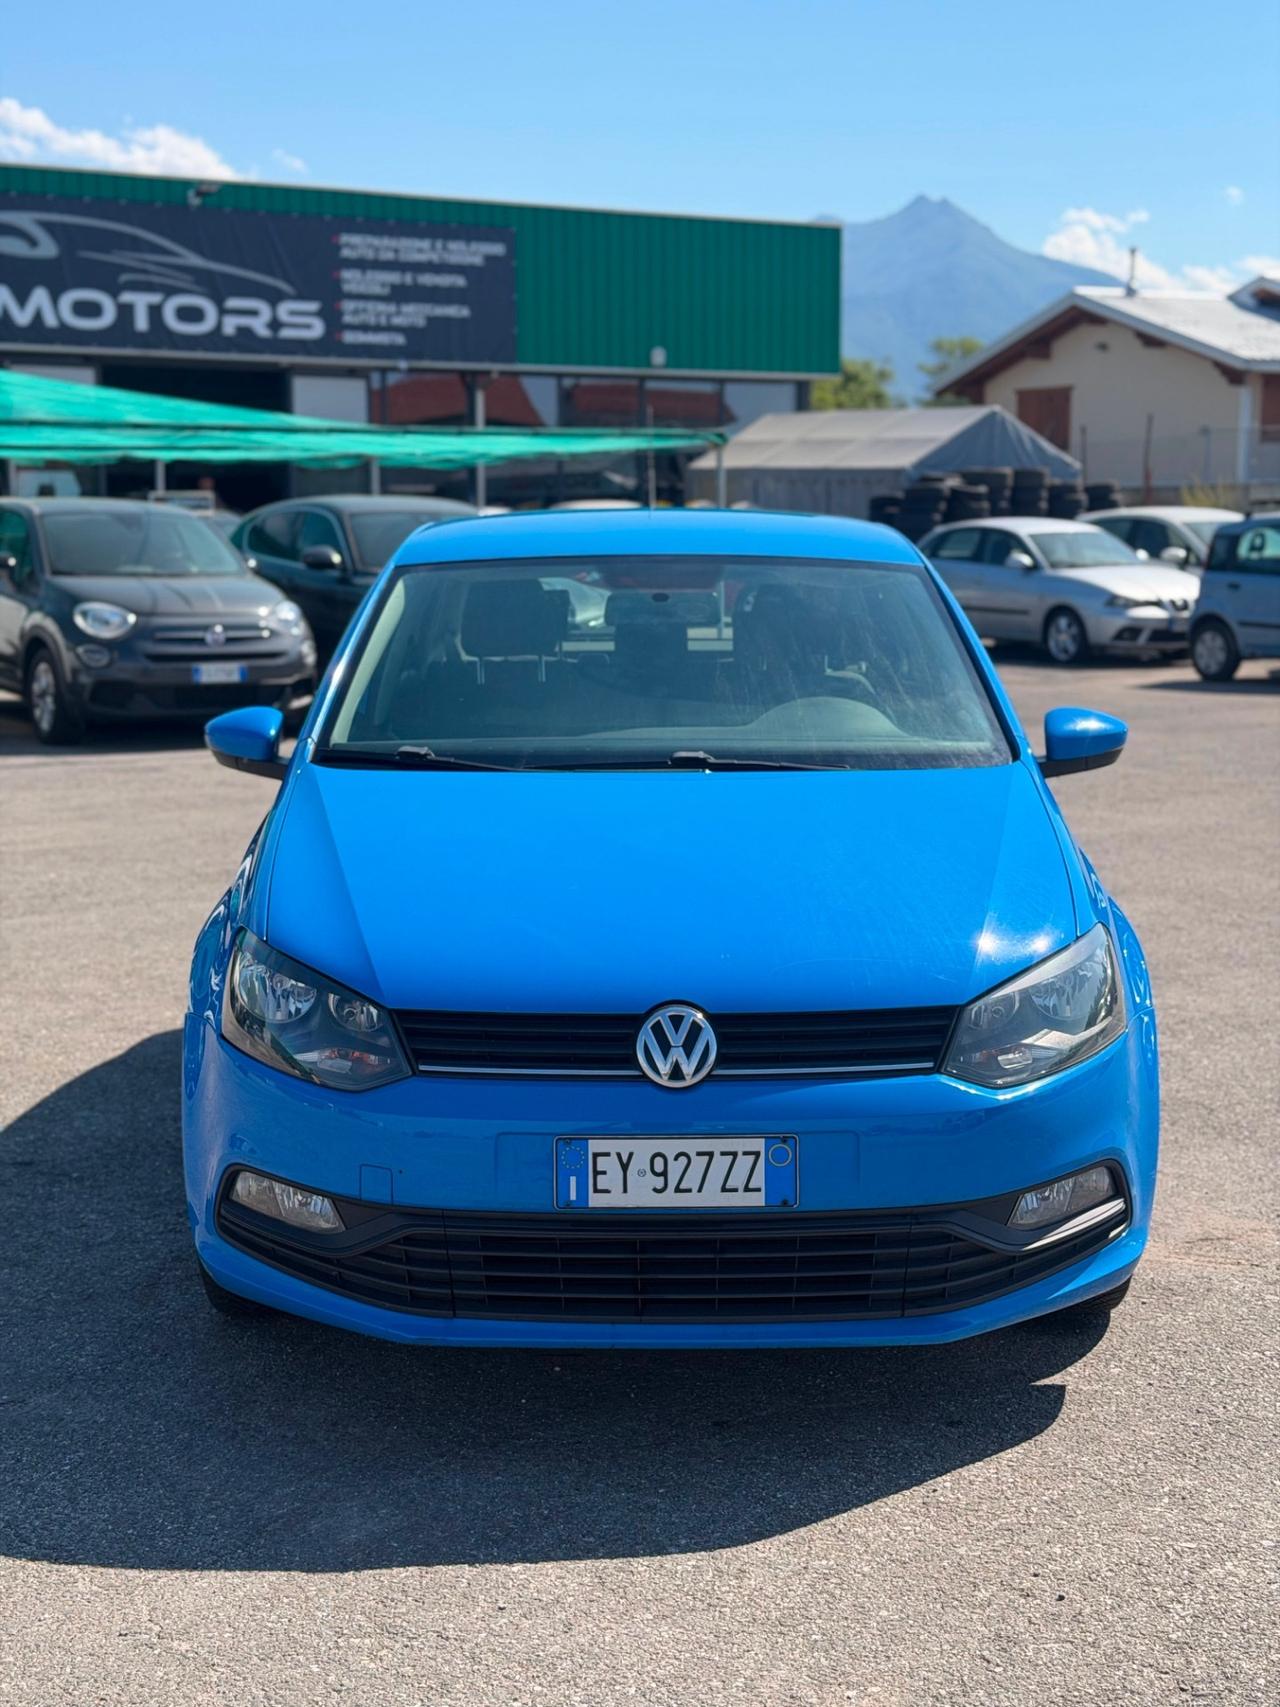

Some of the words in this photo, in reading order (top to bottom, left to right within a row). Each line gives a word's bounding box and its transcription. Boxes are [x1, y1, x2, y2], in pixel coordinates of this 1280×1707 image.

[0, 283, 325, 340] MOTORS
[637, 1005, 717, 1088] VW
[592, 1151, 634, 1194] EY
[649, 1150, 762, 1194] 927ZZ
